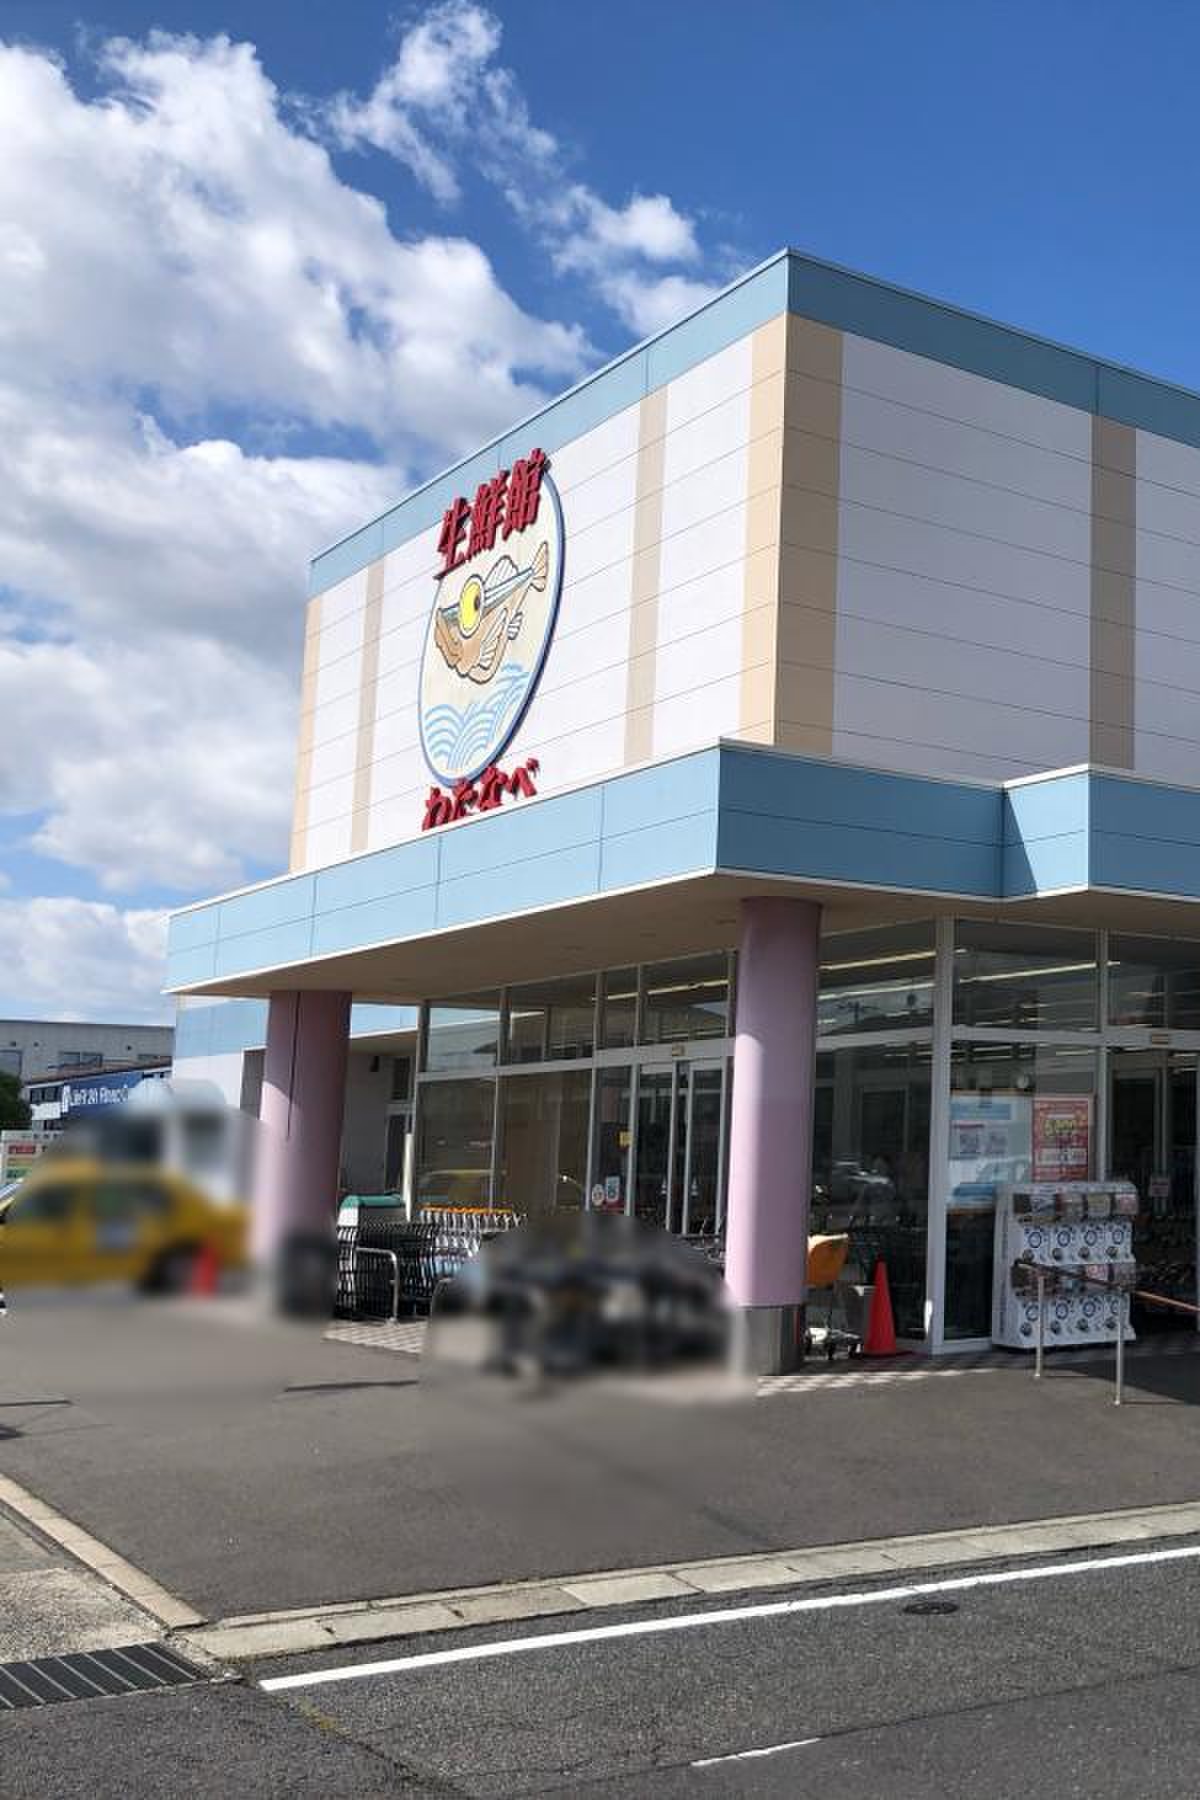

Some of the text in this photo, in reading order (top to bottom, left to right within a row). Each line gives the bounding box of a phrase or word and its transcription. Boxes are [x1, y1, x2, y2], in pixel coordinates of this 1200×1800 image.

[434, 448, 549, 579] 生鮮館
[422, 758, 540, 831] わたなべ
